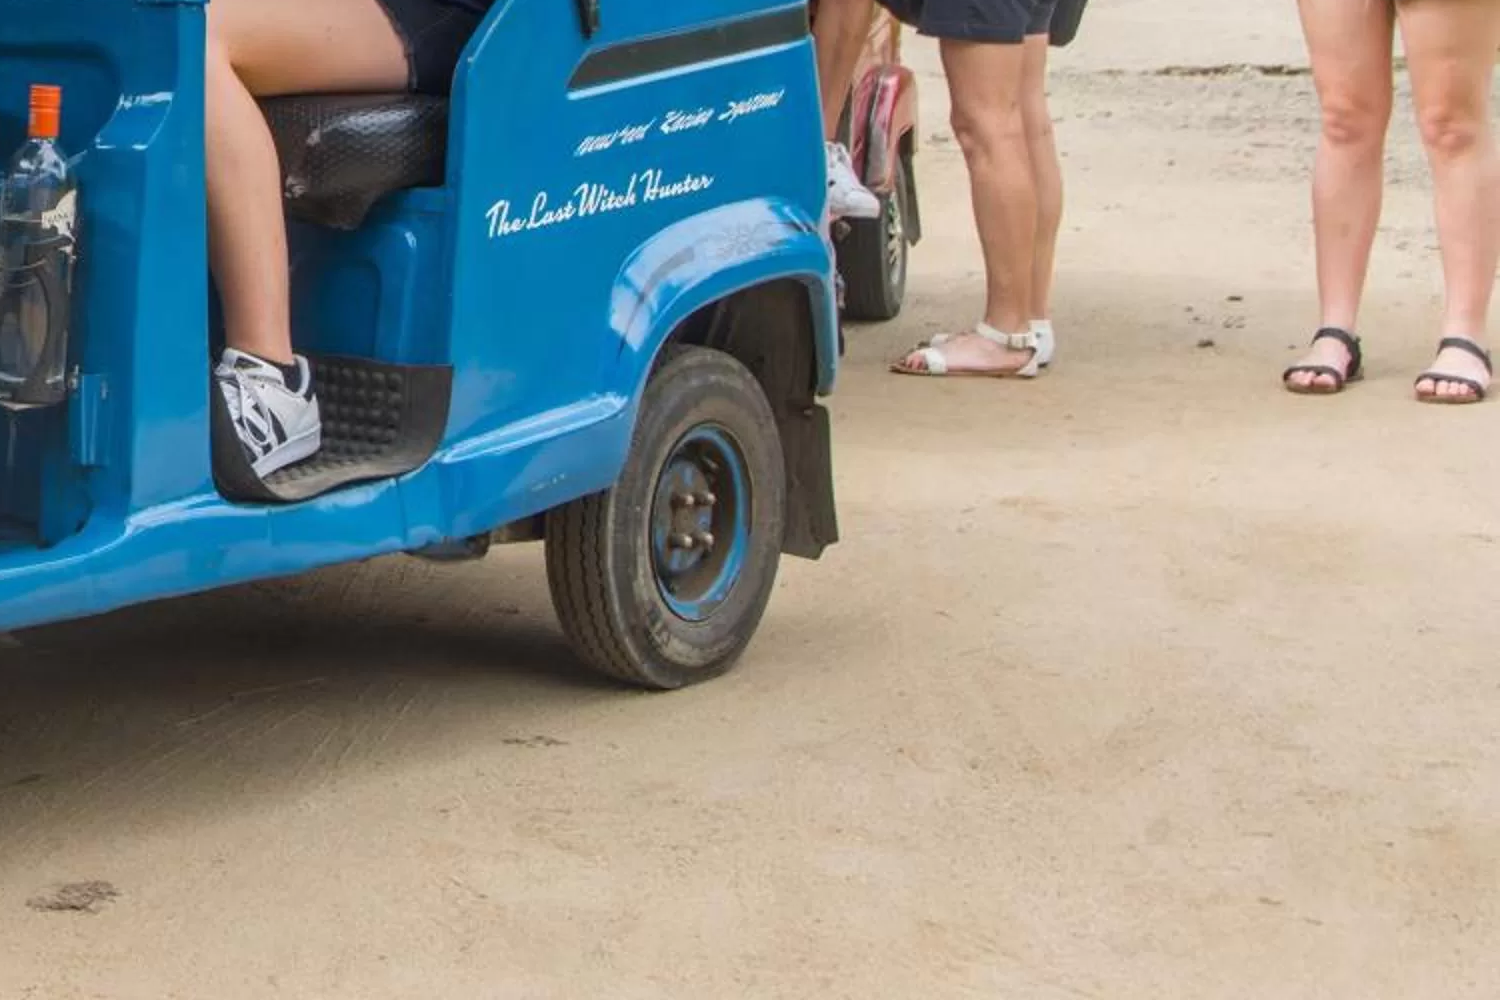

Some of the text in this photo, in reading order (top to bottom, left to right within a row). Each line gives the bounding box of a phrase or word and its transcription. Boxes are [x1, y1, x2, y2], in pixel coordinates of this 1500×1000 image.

[485, 167, 715, 238] The Last Witch Hunter
